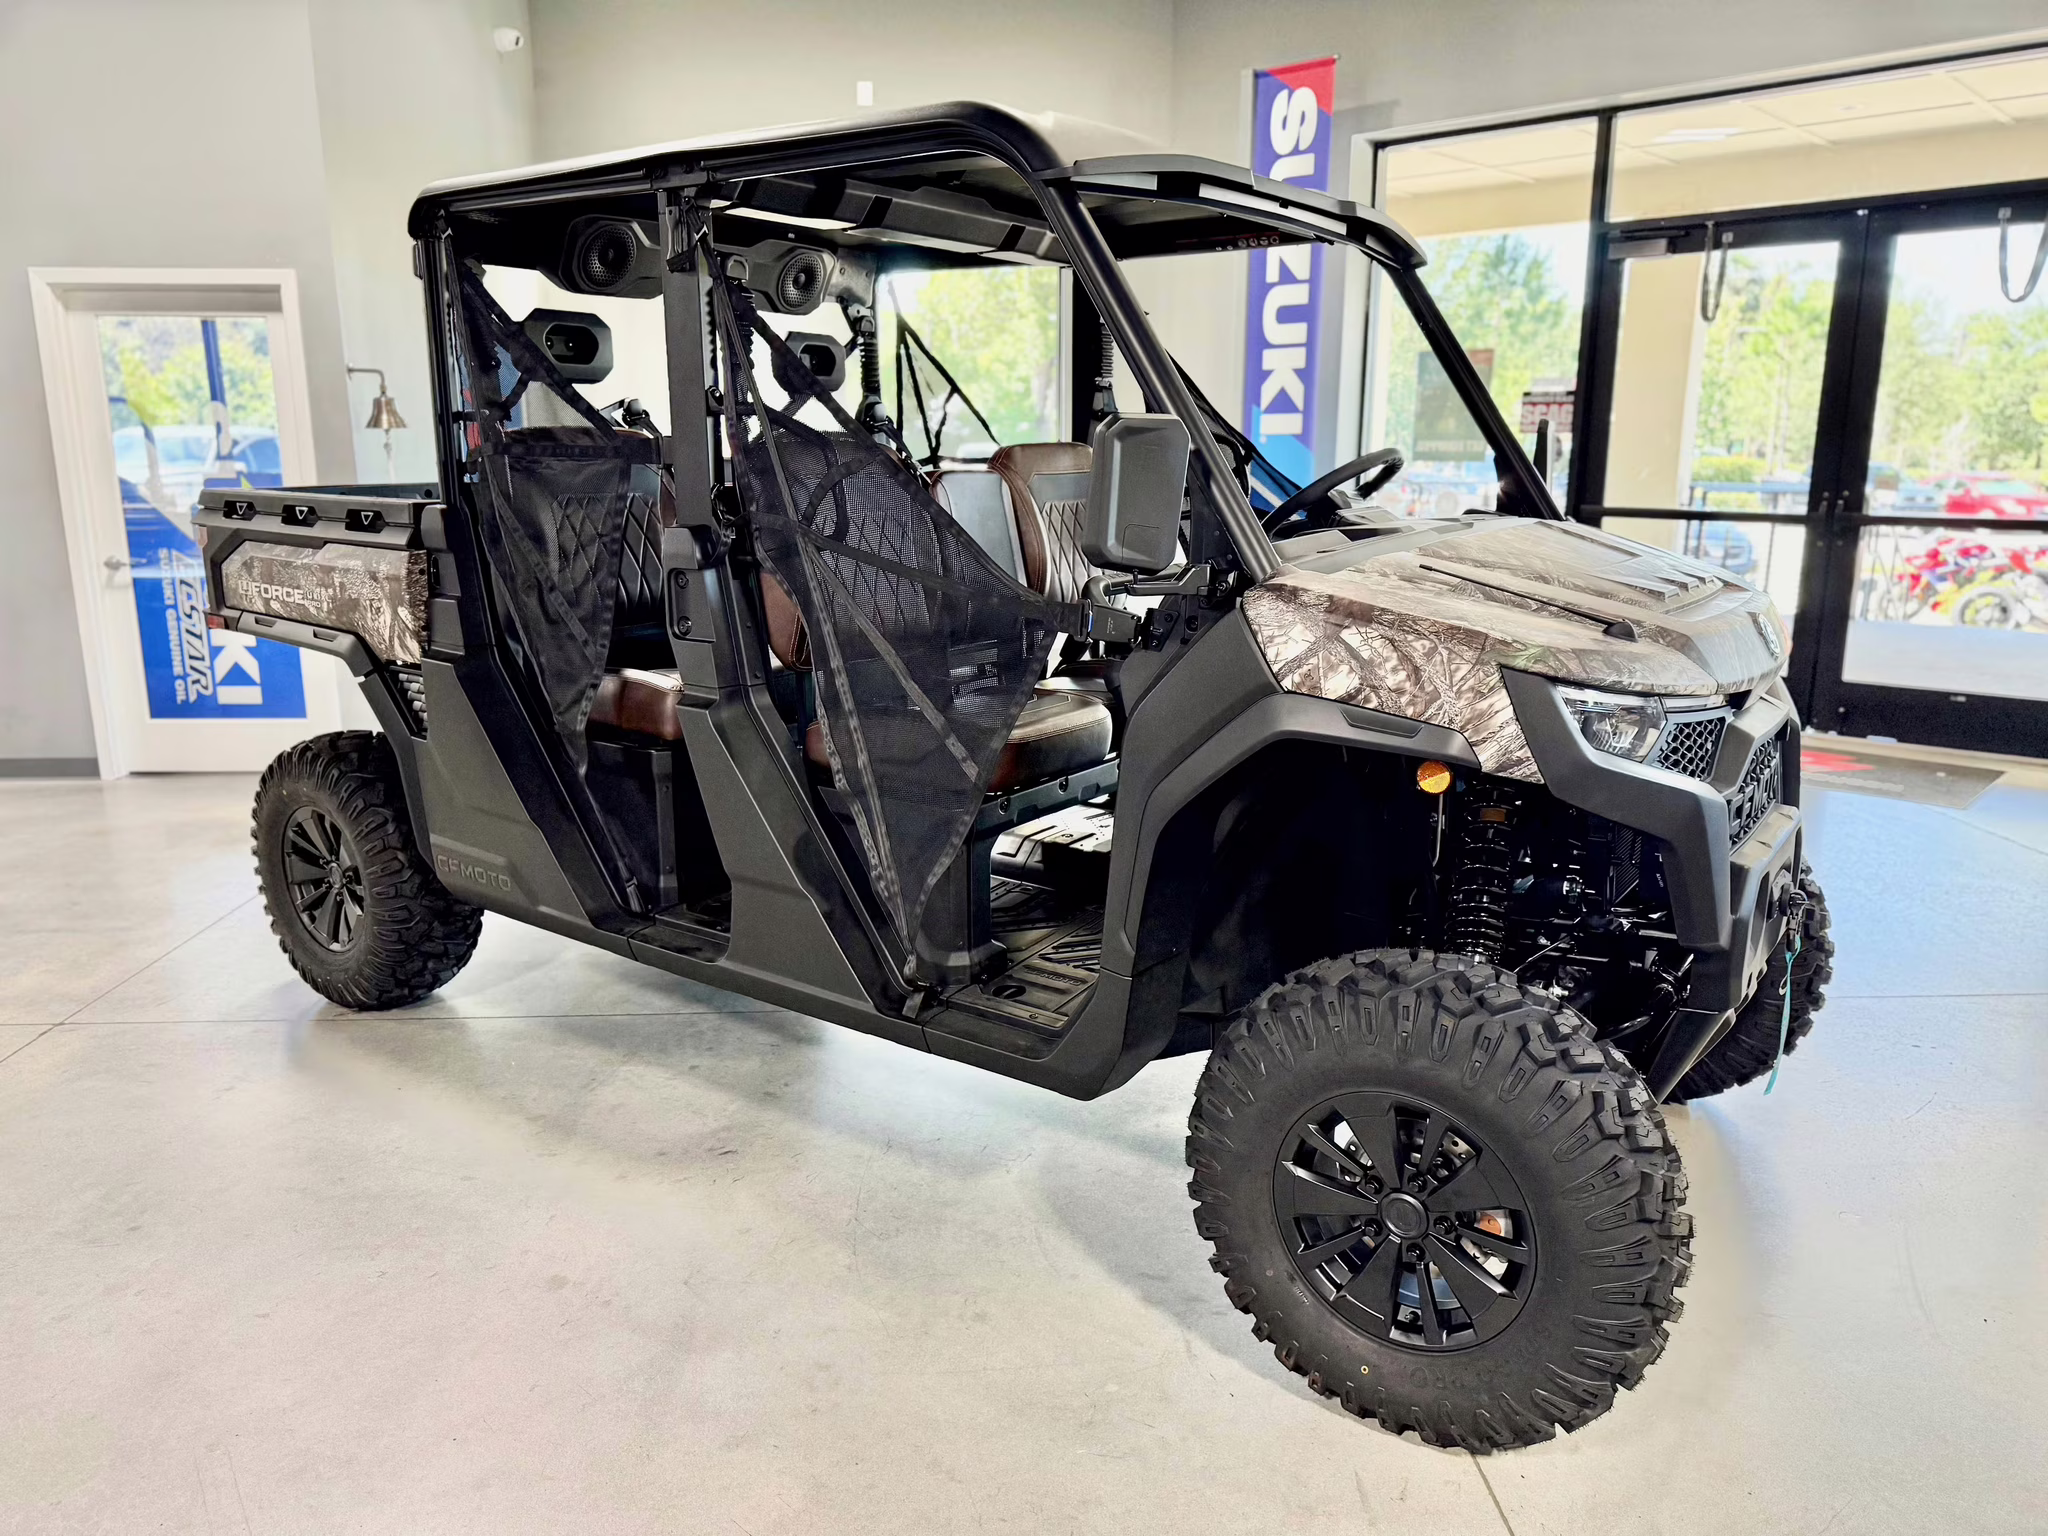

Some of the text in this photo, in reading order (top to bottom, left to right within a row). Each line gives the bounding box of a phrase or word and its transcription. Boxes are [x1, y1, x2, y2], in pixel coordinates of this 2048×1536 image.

[166, 609, 183, 676] GENUINE
[175, 680, 187, 704] OIL
[437, 854, 511, 892] CFMOTO
